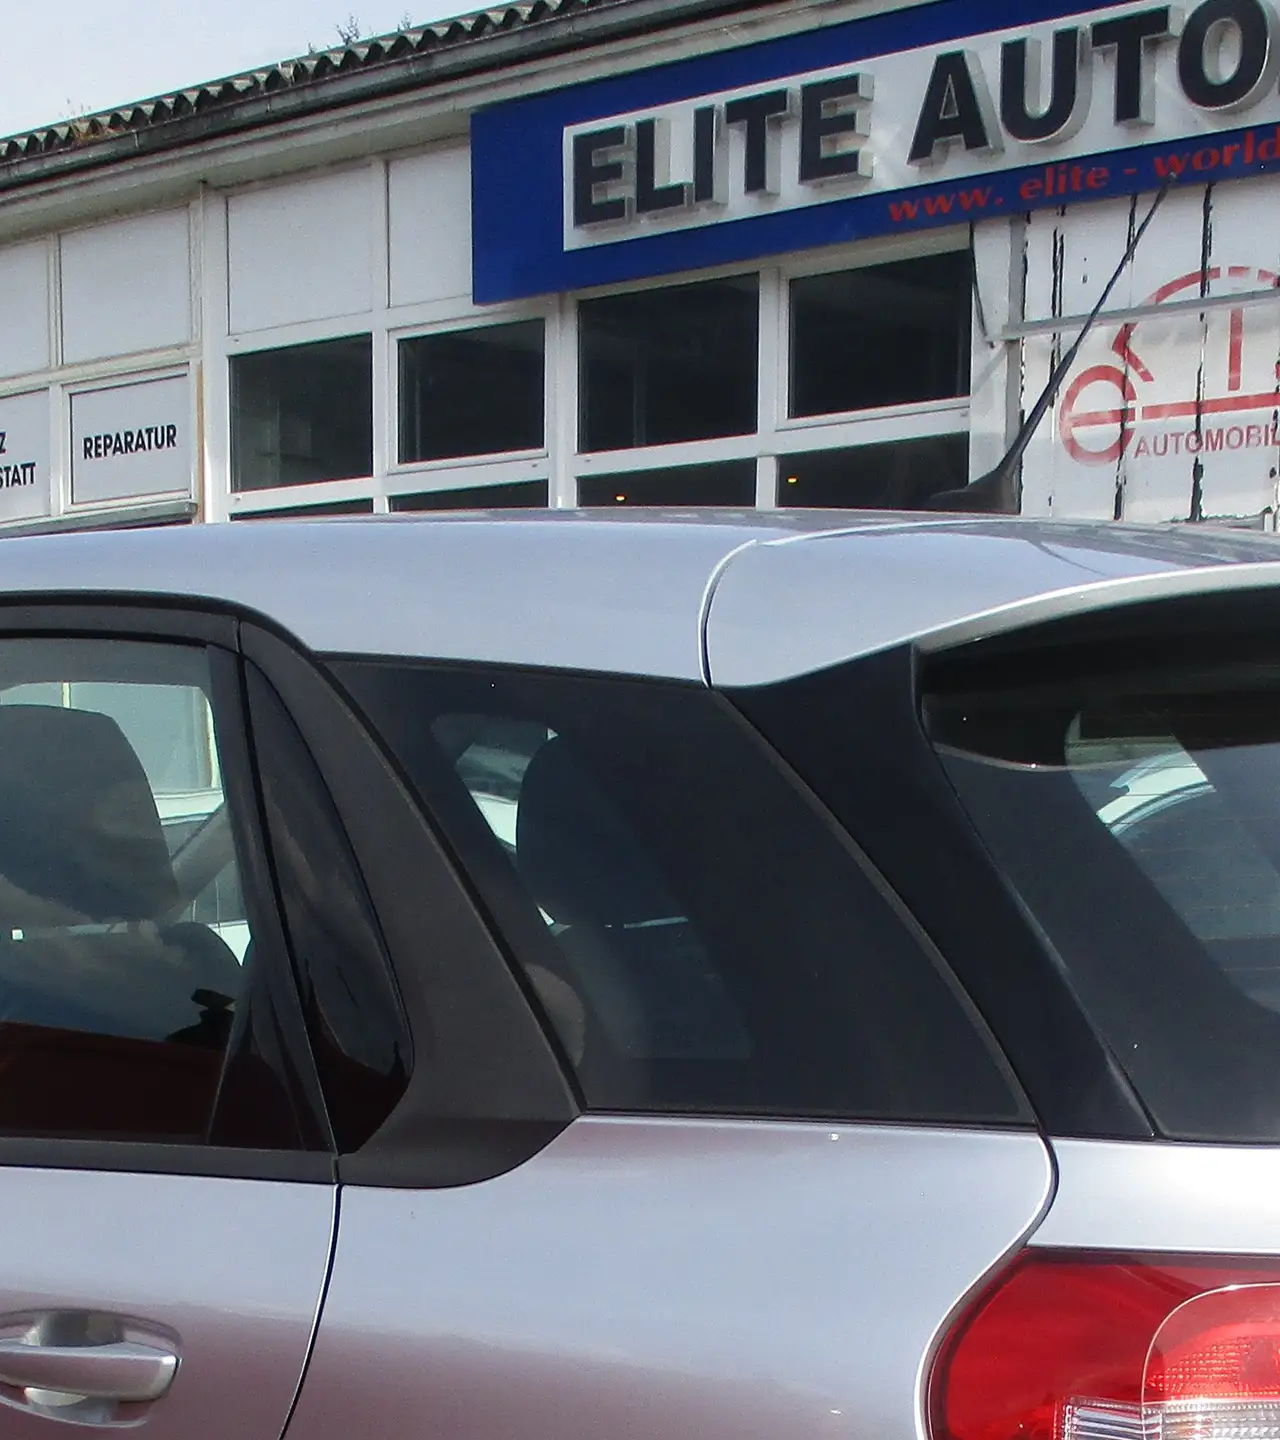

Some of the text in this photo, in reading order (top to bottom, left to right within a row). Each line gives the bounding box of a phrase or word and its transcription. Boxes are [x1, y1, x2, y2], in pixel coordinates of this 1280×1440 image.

[573, 76, 870, 228] ELITE
[1019, 165, 1109, 201] elite
[83, 424, 177, 460] REPARATUR
